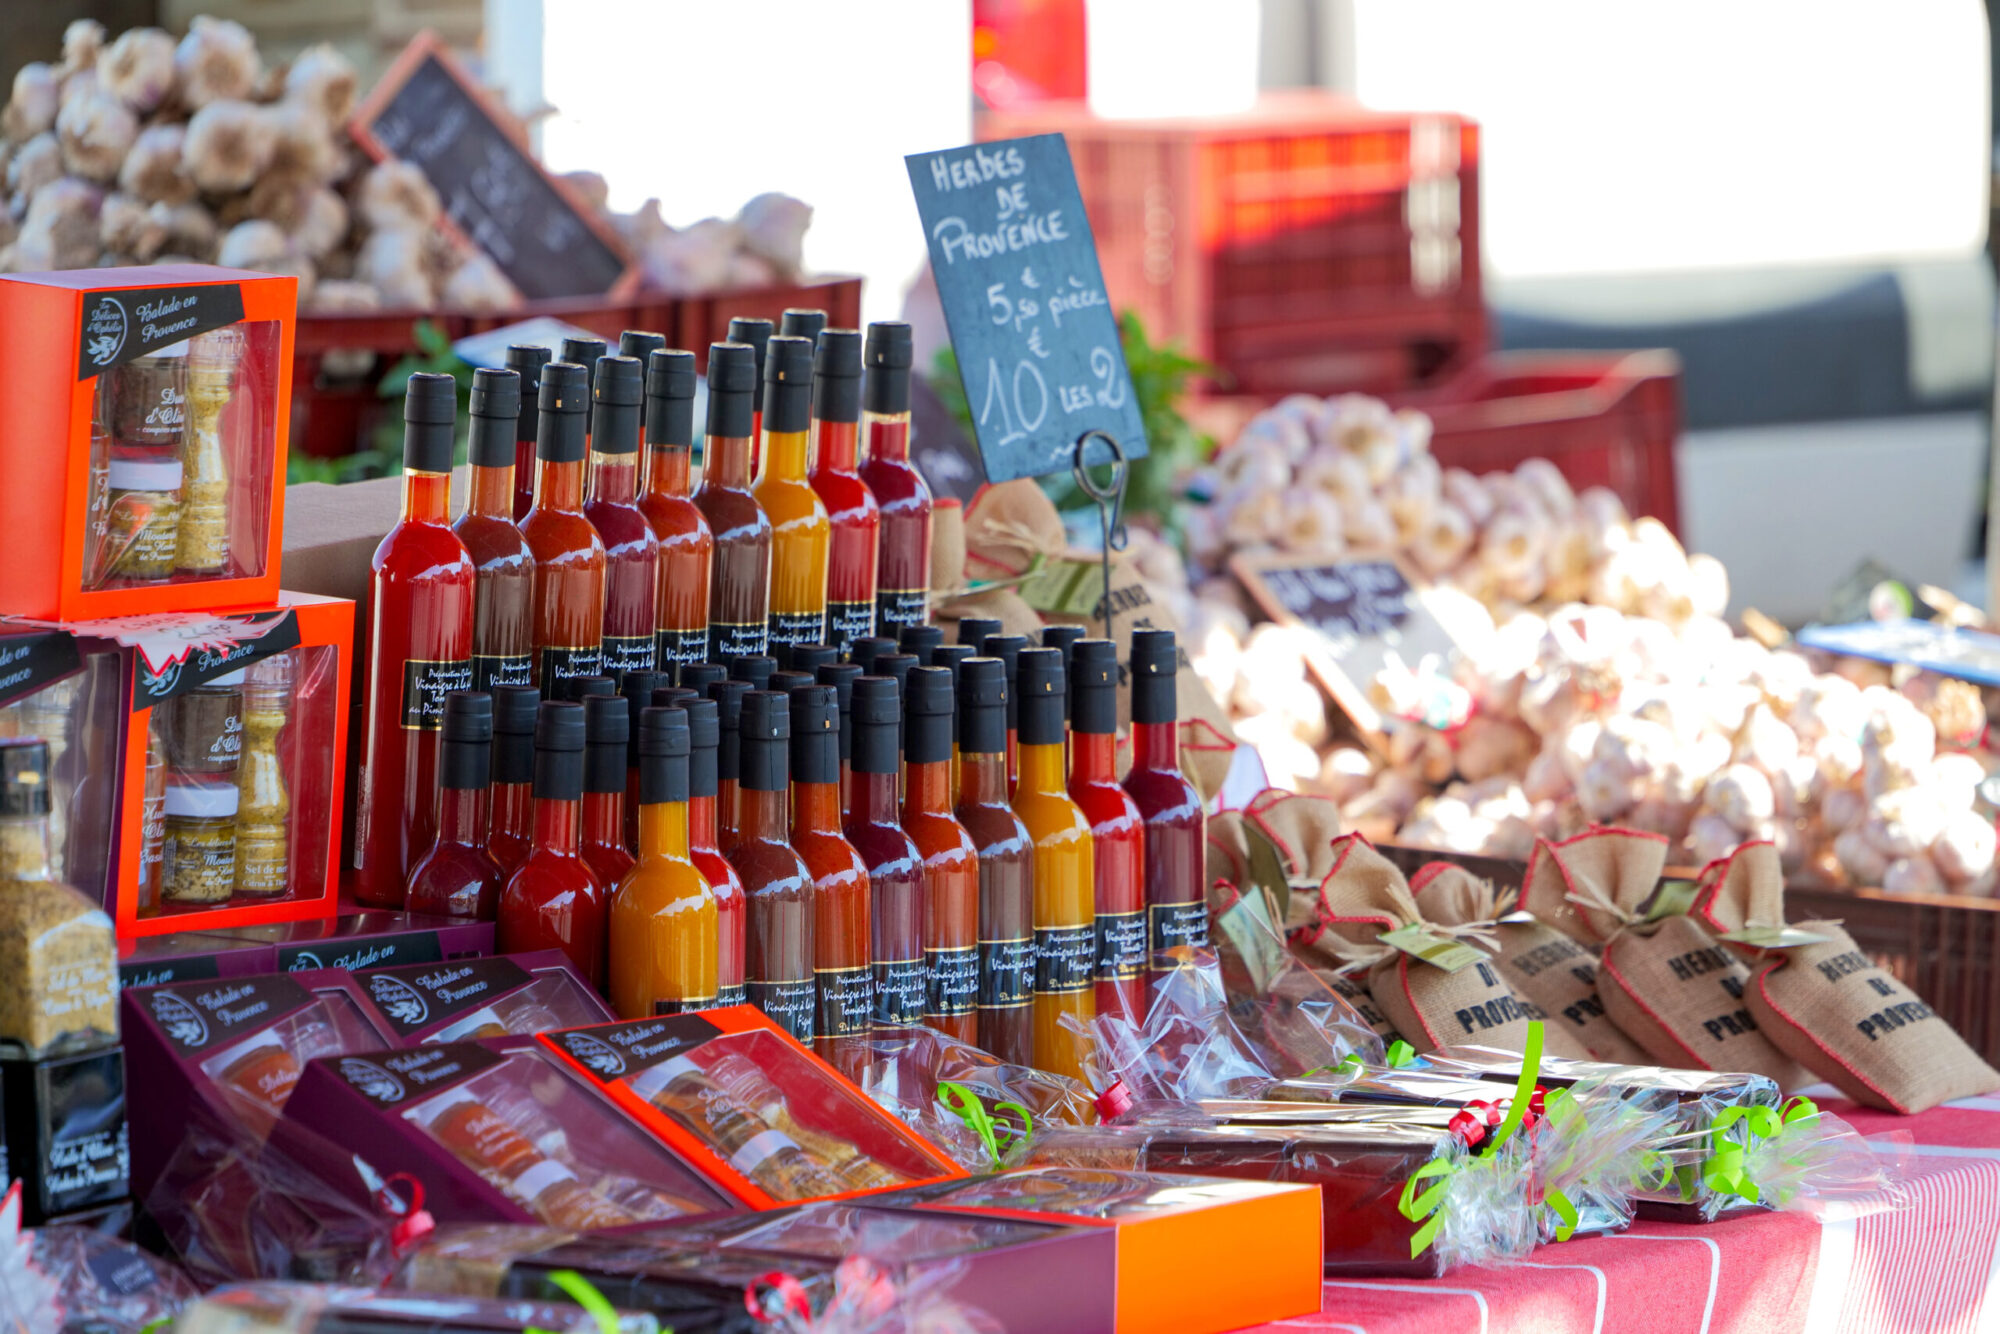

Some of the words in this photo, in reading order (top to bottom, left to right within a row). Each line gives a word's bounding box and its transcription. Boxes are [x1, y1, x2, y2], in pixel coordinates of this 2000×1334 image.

[996, 182, 1029, 221] DE
[933, 210, 1069, 264] PROVENCE
[136, 299, 182, 323] Balade
[183, 295, 198, 308] en
[142, 316, 198, 343] Provence
[980, 357, 1048, 446] 10
[1059, 384, 1091, 414] LES
[1090, 346, 1126, 410] 2
[603, 655, 639, 672] Vinaigre
[415, 676, 453, 695] Vinaigre
[454, 679, 459, 690] à
[263, 862, 274, 874] de
[381, 945, 396, 957] en
[1035, 944, 1074, 963] Vinaigre
[1074, 945, 1081, 956] à
[926, 966, 962, 984] Vinaigre
[963, 968, 968, 978] à
[992, 958, 1025, 975] Vinaigre
[823, 987, 860, 1004] Vinaigre
[860, 988, 865, 998] à
[876, 981, 911, 998] Vinaigre
[912, 982, 917, 992] à
[942, 982, 969, 995] Tomate
[764, 1000, 799, 1016] Vinaigre
[799, 1001, 805, 1011] à
[841, 1003, 867, 1016] Tomate
